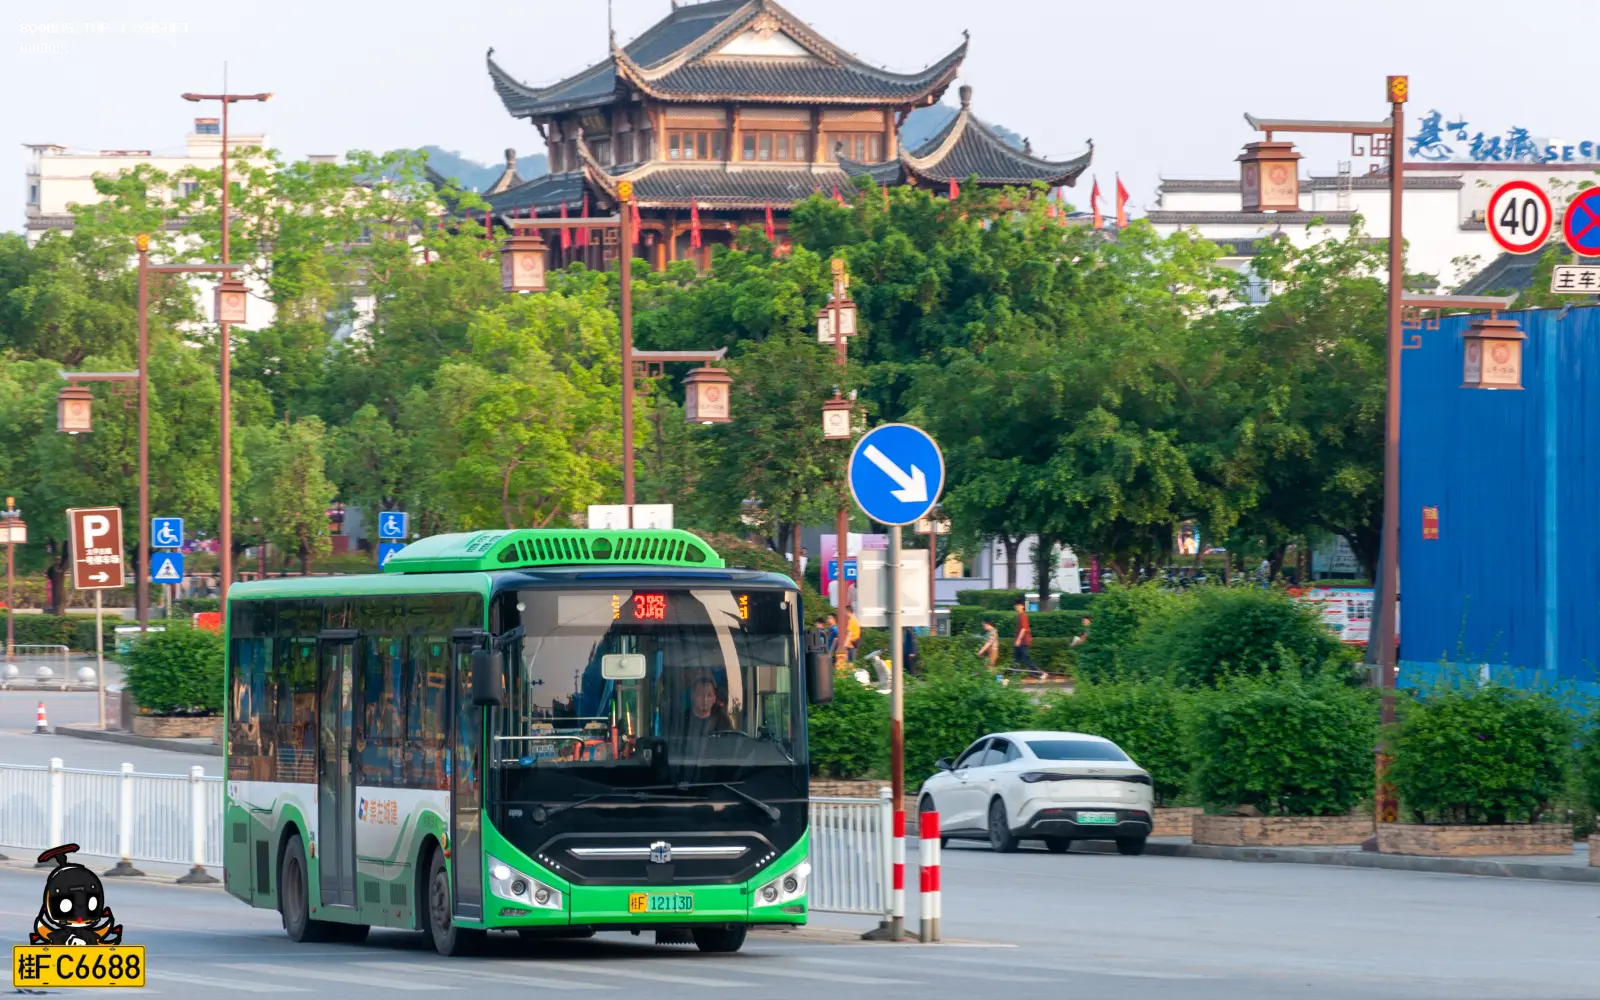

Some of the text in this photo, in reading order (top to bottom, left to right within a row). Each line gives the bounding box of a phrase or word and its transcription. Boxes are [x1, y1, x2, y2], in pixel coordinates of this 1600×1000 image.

[1544, 140, 1600, 162] SEC
[1500, 197, 1538, 236] 40
[1557, 270, 1600, 288] 主车
[82, 515, 110, 548] P
[633, 594, 666, 619] 3路
